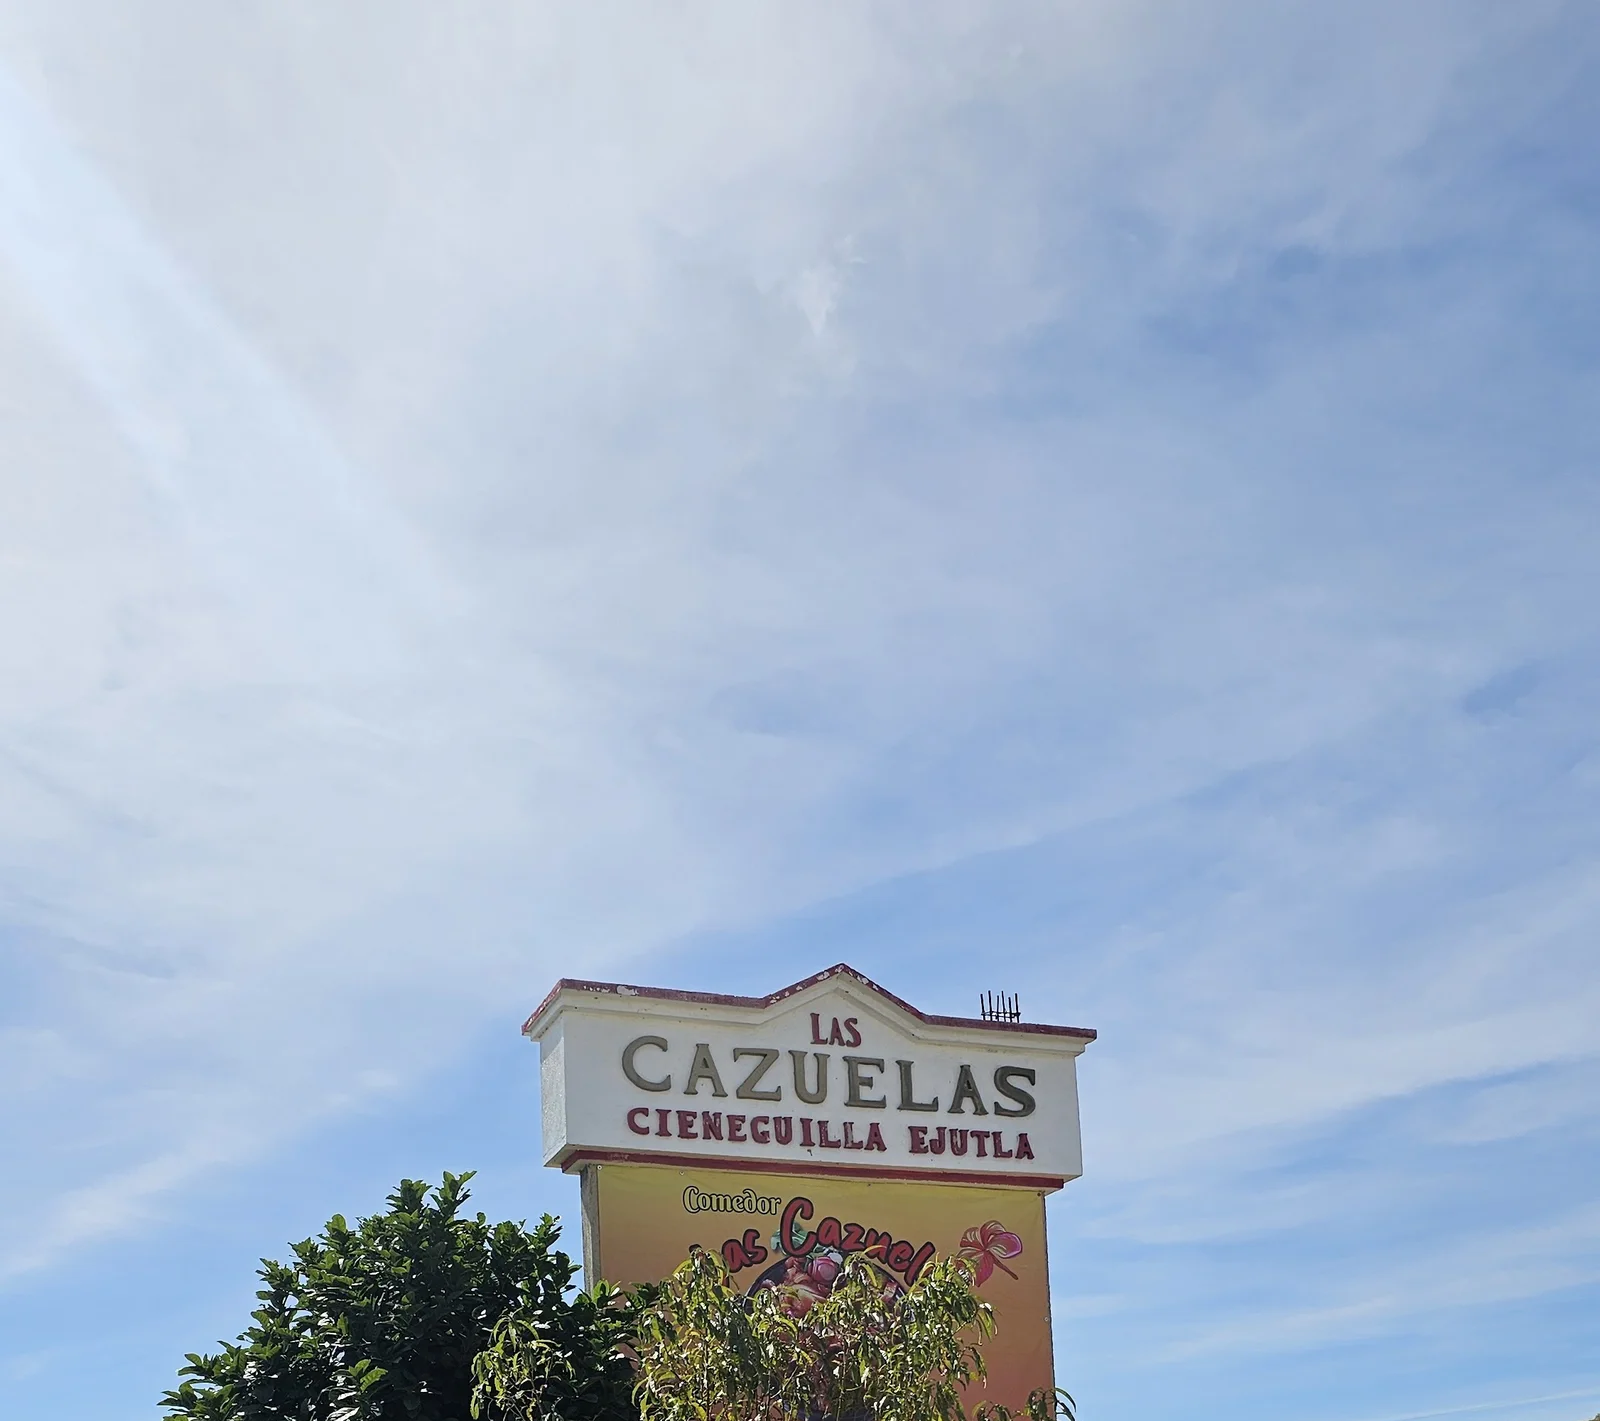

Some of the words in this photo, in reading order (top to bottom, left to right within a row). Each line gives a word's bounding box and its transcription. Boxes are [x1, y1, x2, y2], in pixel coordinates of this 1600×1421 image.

[810, 1012, 862, 1048] LAS
[621, 1034, 1036, 1118] CAZUELAS
[626, 1106, 887, 1152] CIENEGUILLA
[908, 1125, 1035, 1160] EJUTLA
[683, 1185, 782, 1216] Comedor
[689, 1228, 768, 1288] as
[780, 1196, 938, 1289] Cazuel
